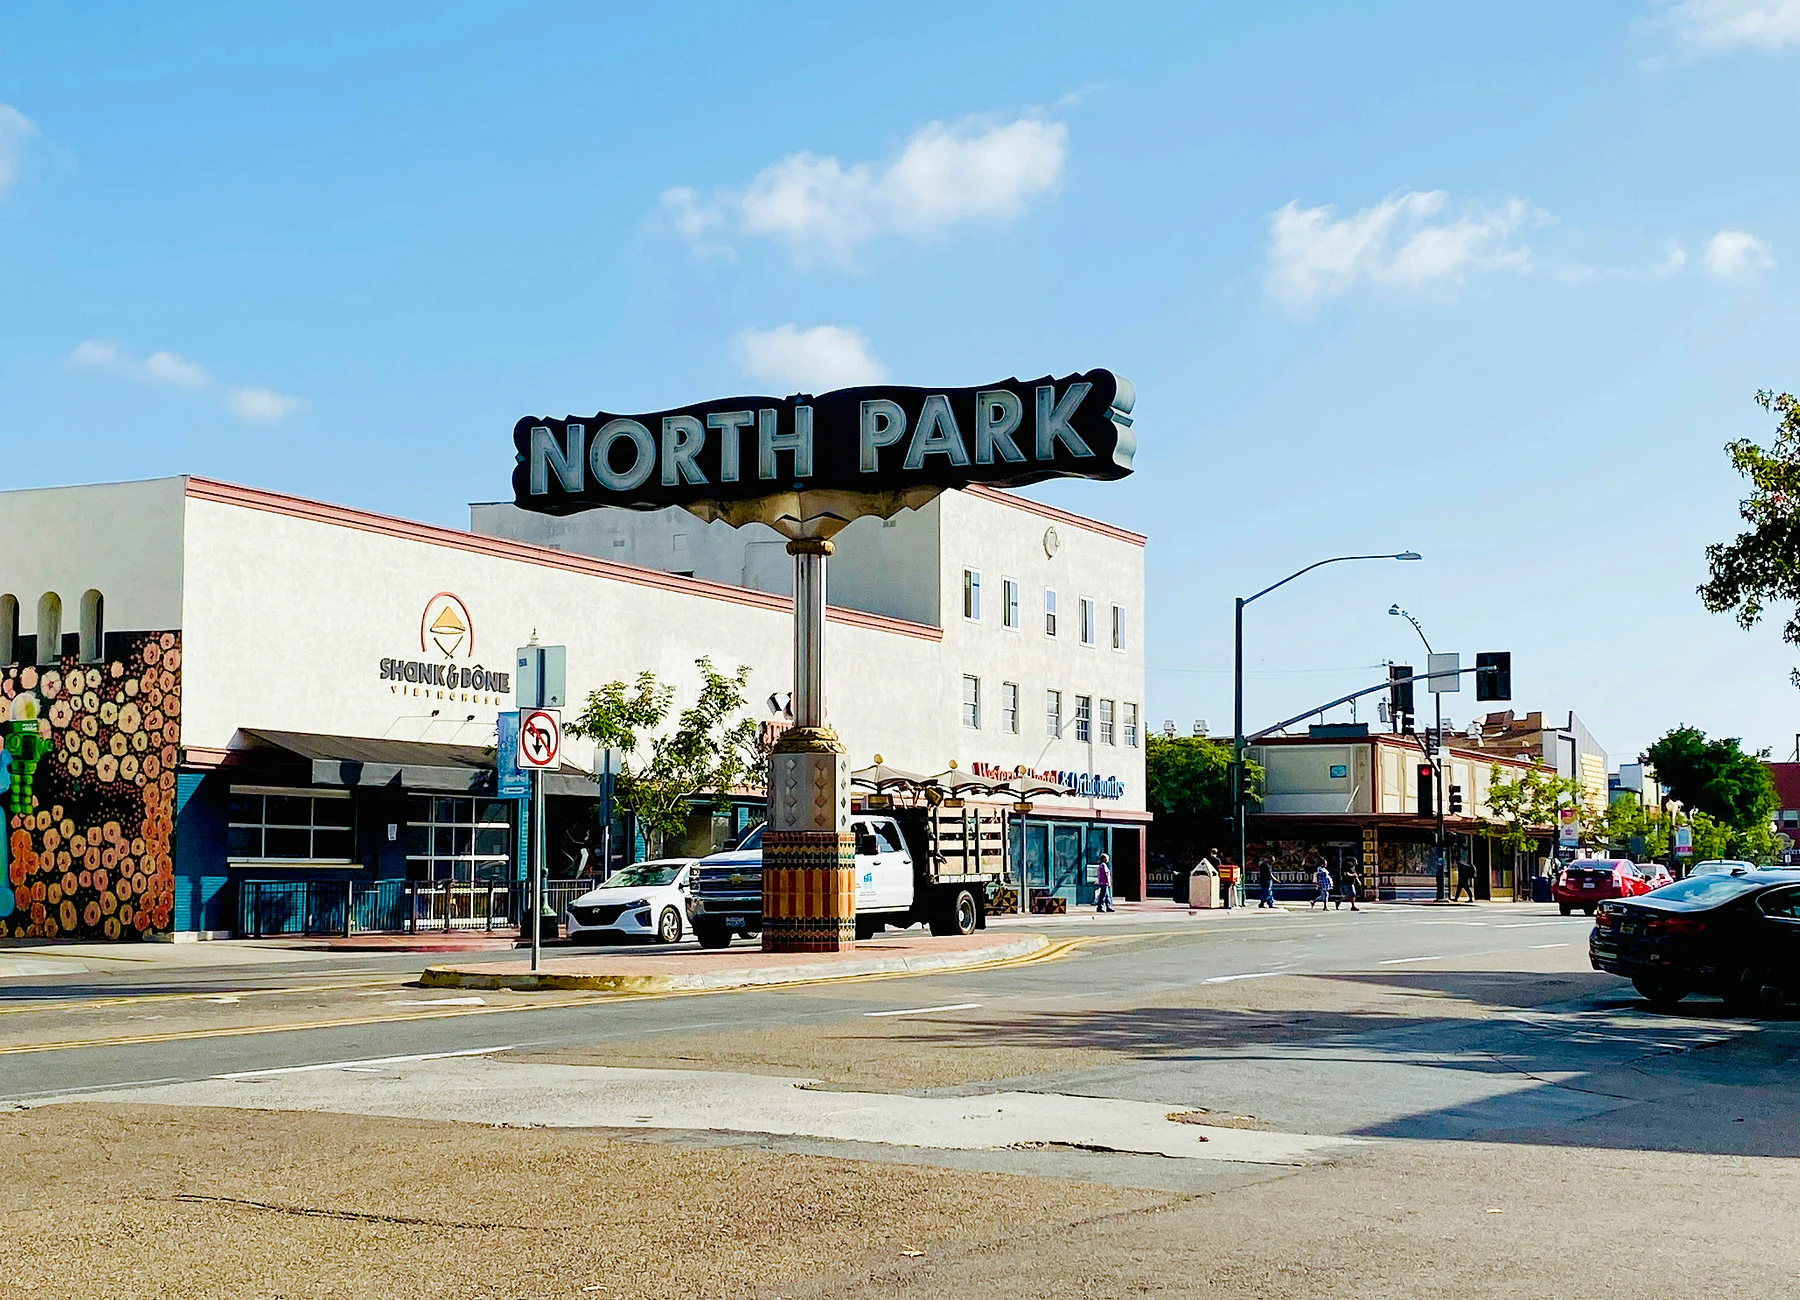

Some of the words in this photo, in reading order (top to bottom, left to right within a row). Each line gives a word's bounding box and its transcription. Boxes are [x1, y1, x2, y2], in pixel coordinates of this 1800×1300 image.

[530, 405, 814, 496] NORTH
[859, 382, 1097, 473] PARK
[380, 658, 446, 686] SHANK
[461, 664, 510, 693] BÔNE
[1070, 772, 1124, 797] Orthodontics
